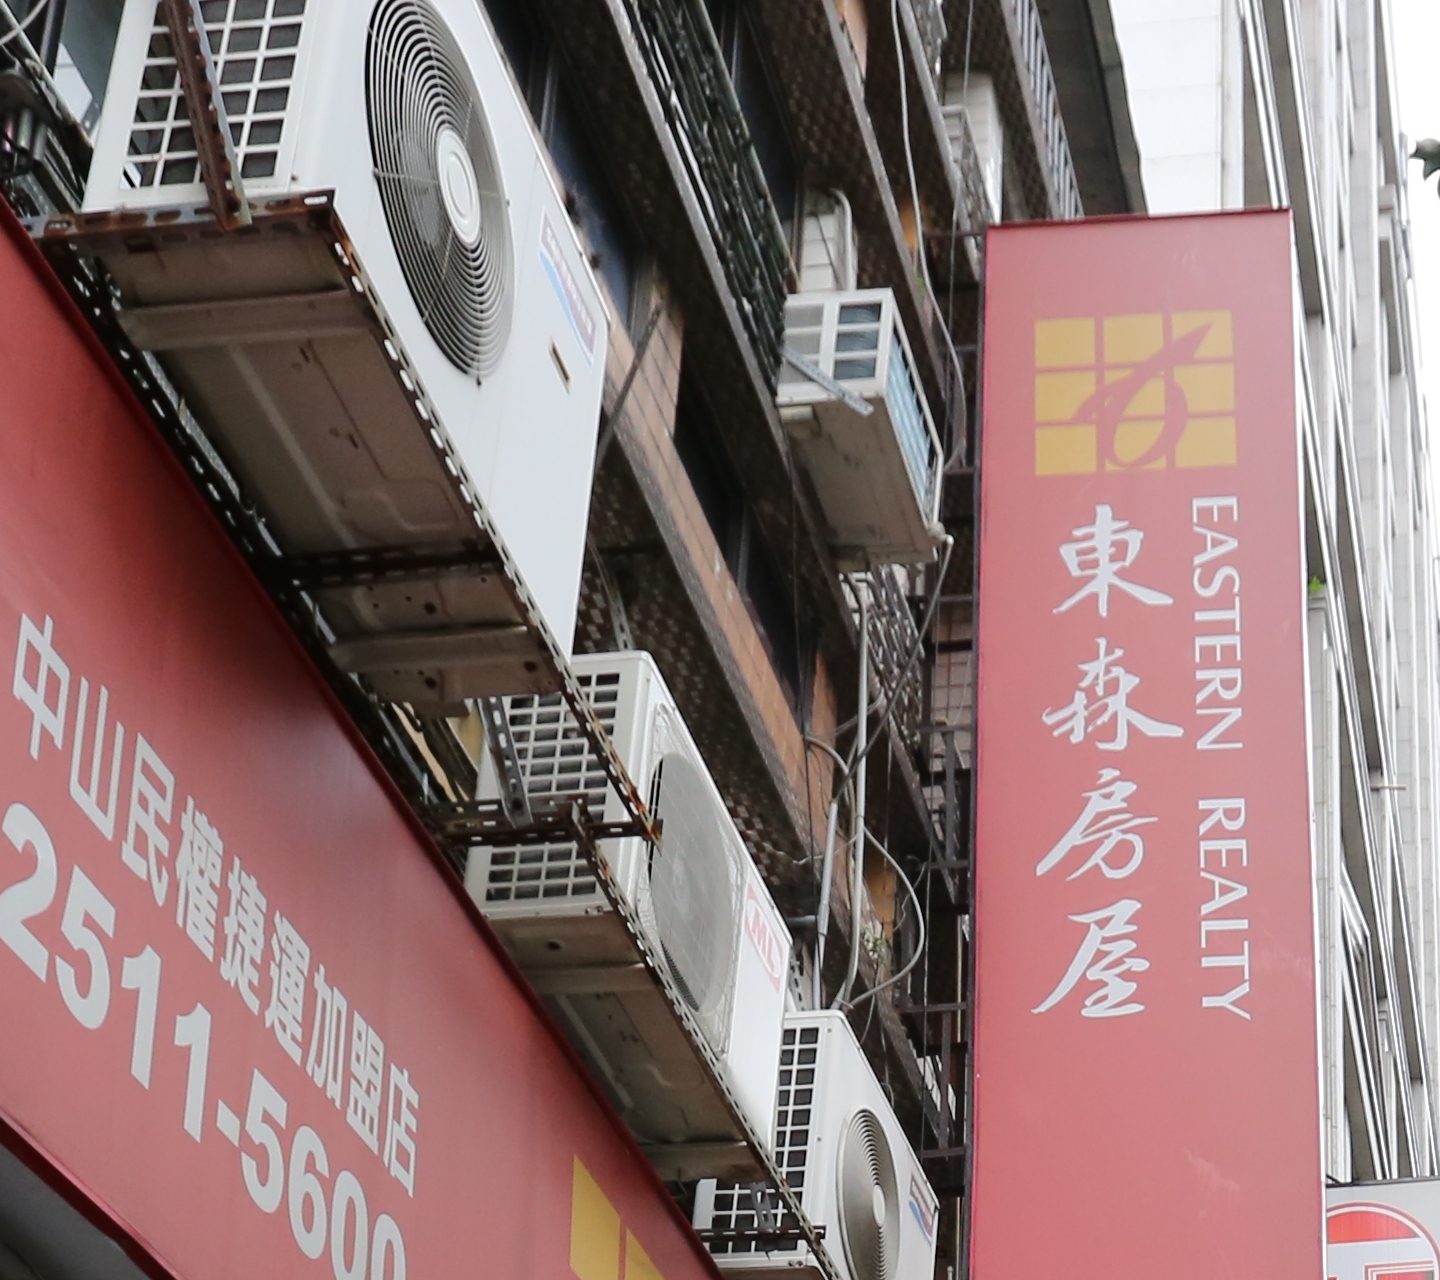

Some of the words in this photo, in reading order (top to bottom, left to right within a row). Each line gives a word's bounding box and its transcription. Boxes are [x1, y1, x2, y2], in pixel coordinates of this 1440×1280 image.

[1031, 504, 1183, 1018] 東森房屋
[1192, 495, 1243, 751] EASTERN
[12, 614, 420, 1198] 中山民權捷運加盟店
[1198, 798, 1251, 1020] REALTY
